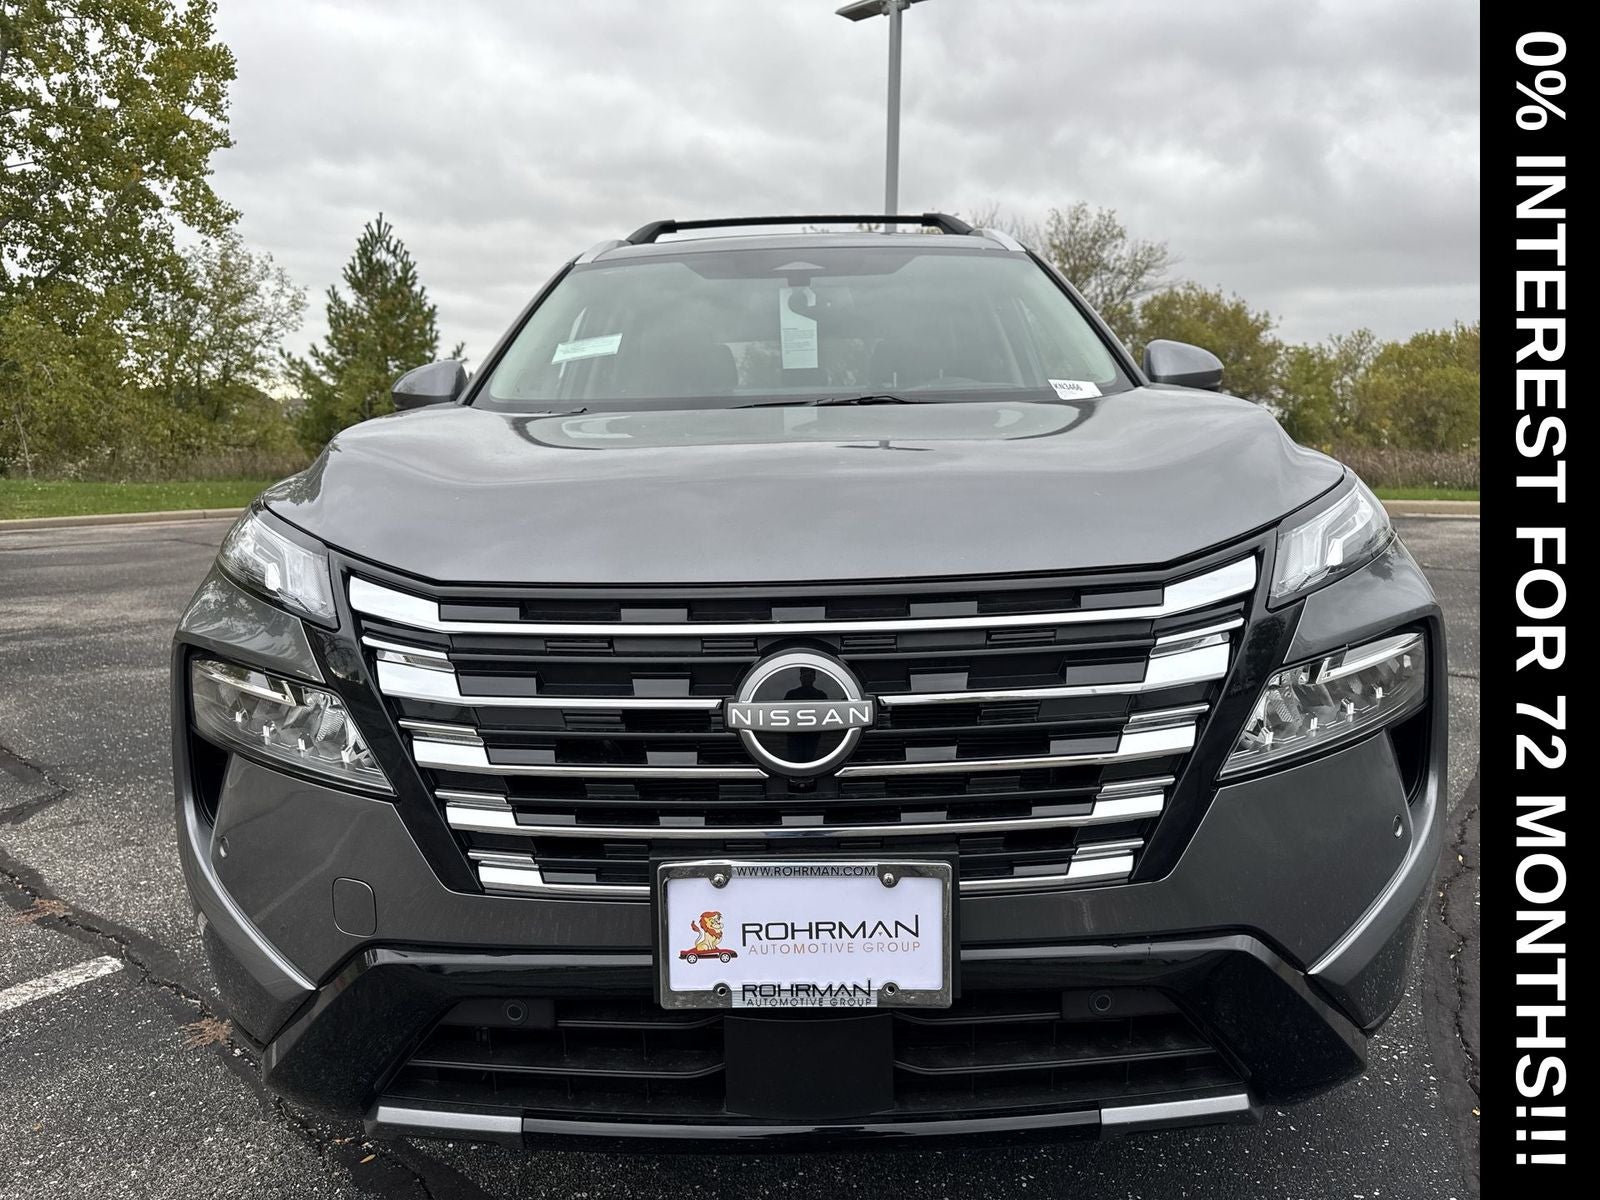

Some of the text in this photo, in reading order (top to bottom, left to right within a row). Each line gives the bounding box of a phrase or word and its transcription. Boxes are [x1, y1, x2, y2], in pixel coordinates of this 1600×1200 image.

[731, 706, 870, 726] NISSAN
[736, 865, 877, 877] WWW.ROHRMAN.COM
[741, 914, 920, 947] ROHRMAN
[748, 941, 921, 955] AUTOMOTIVE GROUP
[742, 979, 872, 1001] ROHRMAN
[746, 996, 872, 1007] AUTOMOTIVE GROUP
